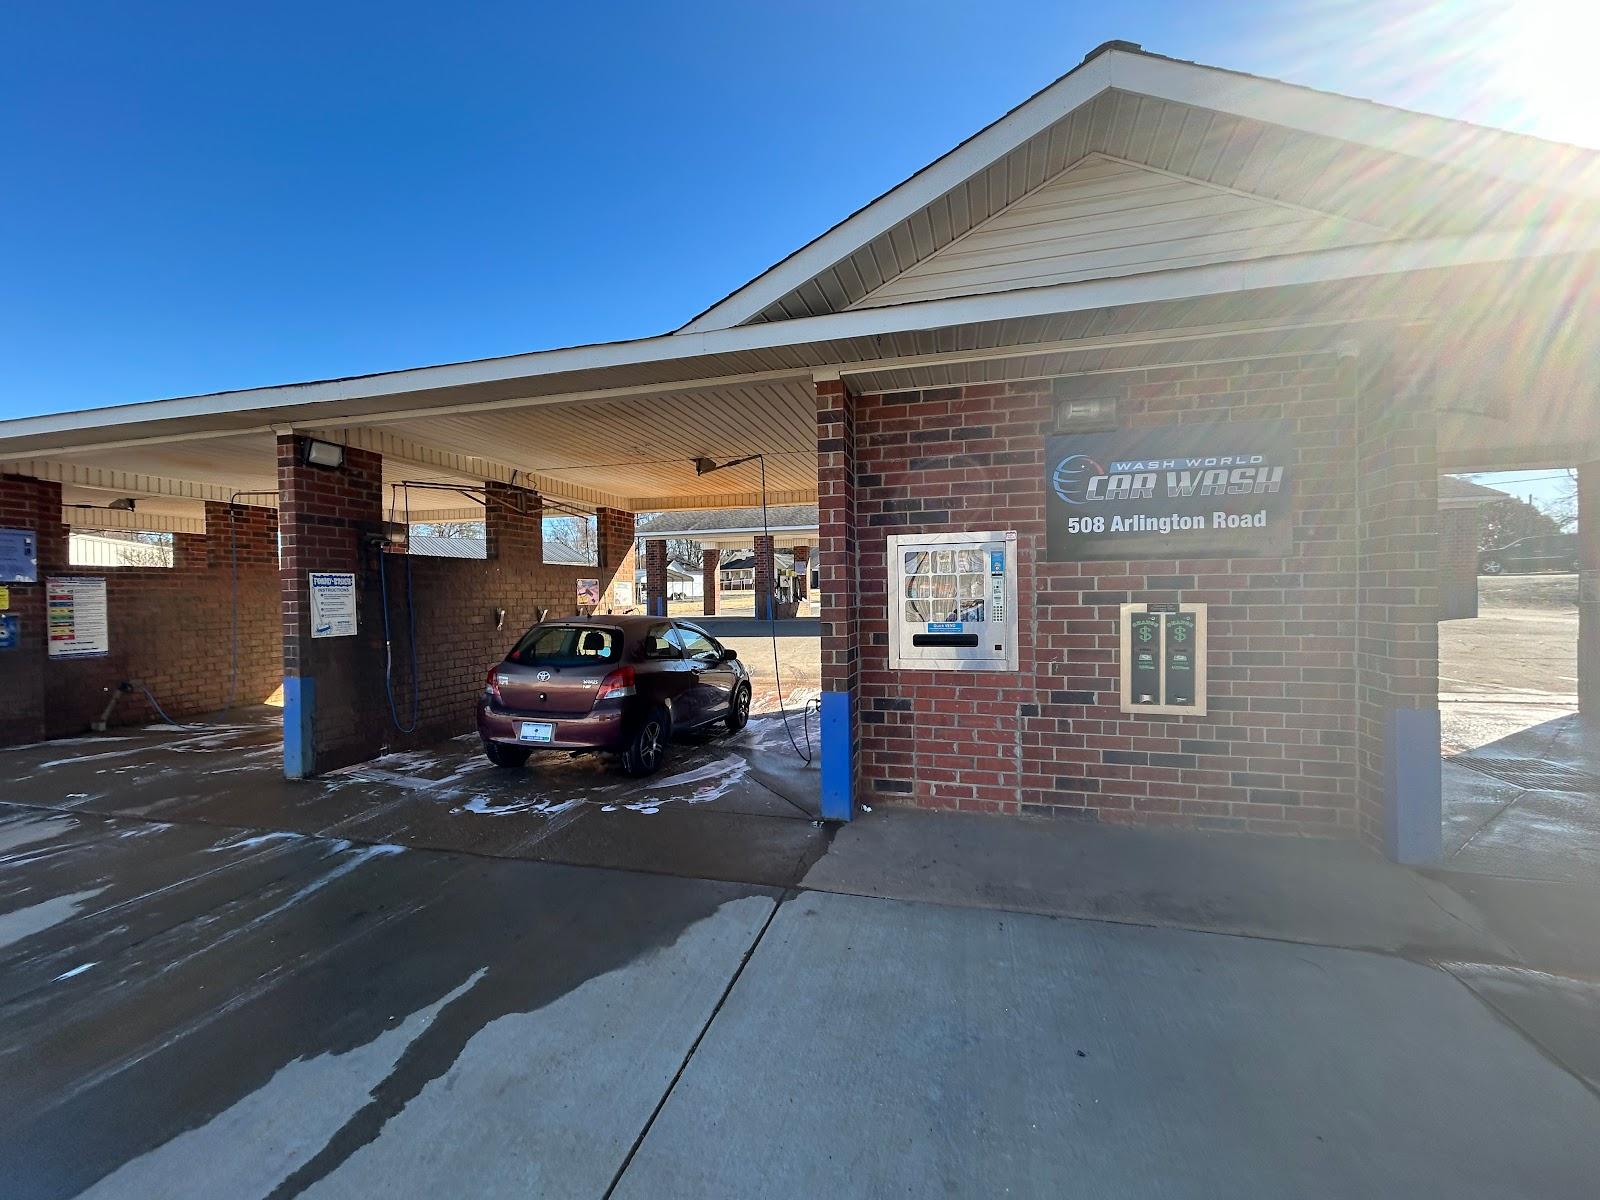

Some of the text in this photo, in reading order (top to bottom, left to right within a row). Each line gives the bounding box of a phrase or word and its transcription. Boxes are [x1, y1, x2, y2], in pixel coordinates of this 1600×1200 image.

[1116, 455, 1263, 470] WASH WORLD
[1085, 466, 1284, 501] CAR WASH
[1068, 510, 1267, 534] 508 Arlington Road
